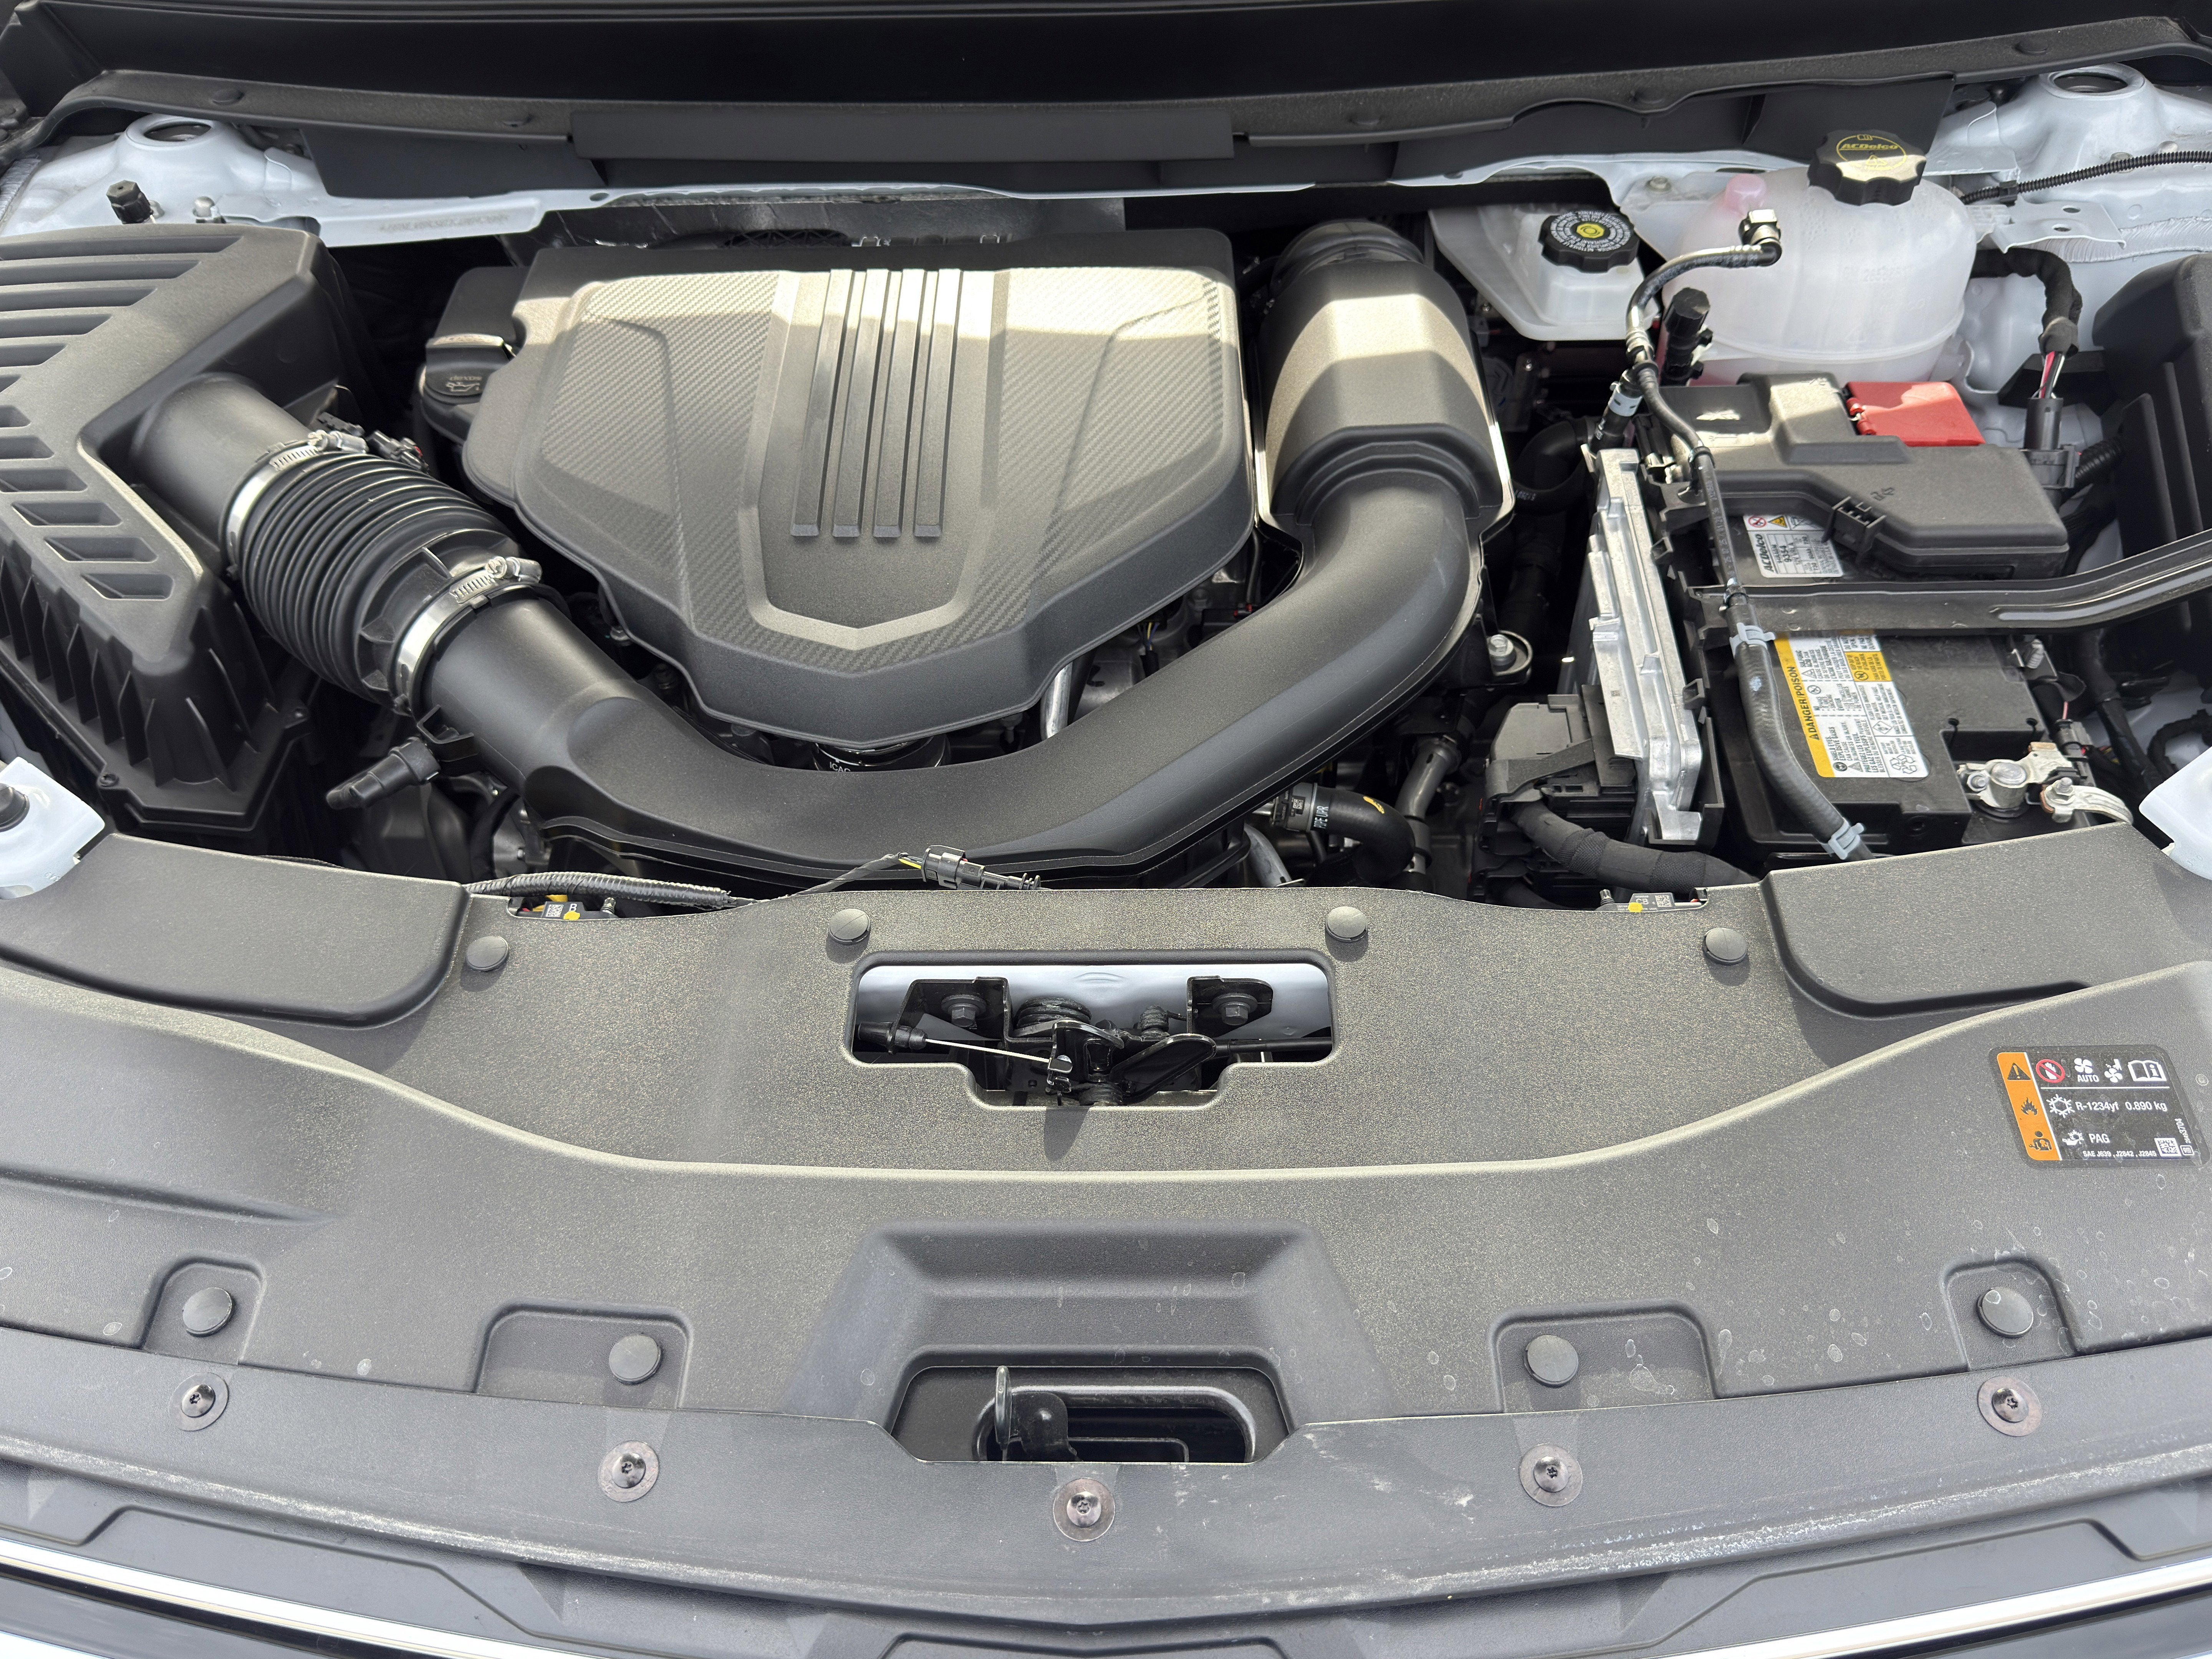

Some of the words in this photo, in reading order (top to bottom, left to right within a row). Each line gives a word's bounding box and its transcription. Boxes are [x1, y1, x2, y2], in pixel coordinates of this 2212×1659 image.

[1753, 533, 1774, 573] ACDelco
[1786, 666, 1817, 733] DANGER/POISON
[568, 903, 577, 911] B
[2077, 1075, 2099, 1083] AUTO
[2075, 1102, 2119, 1112] R-1234yf
[2125, 1101, 2152, 1110] 0.890
[2154, 1102, 2167, 1112] kg
[2088, 1134, 2110, 1143] PAG
